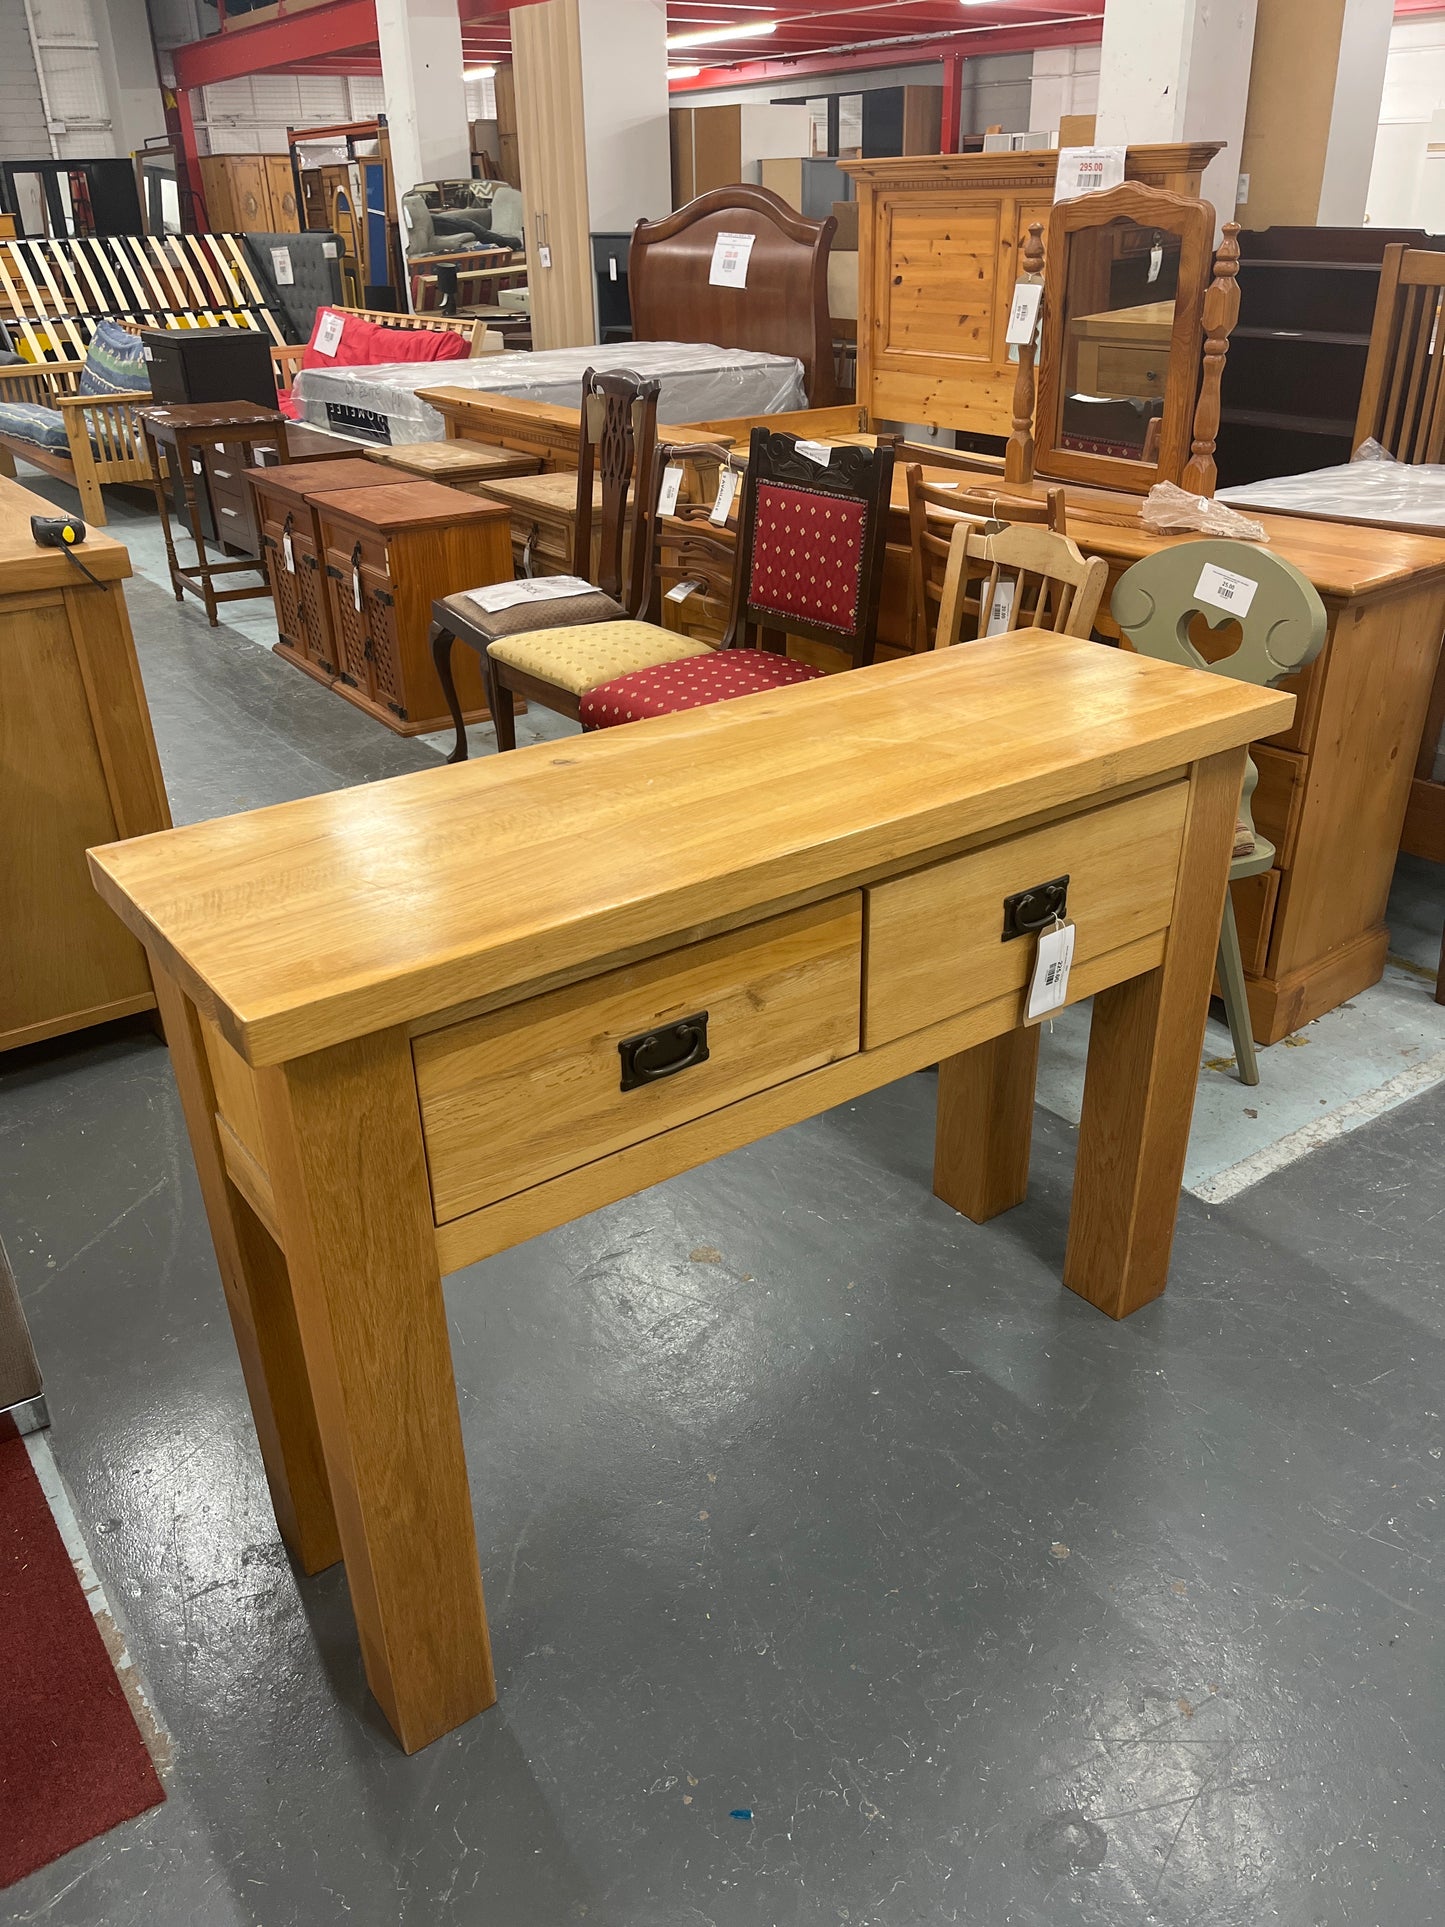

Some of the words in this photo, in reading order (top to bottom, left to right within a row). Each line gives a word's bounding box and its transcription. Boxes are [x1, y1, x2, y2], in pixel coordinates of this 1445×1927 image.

[1079, 162, 1103, 172] 295.00
[1222, 581, 1236, 591] 25.00
[1053, 960, 1063, 983] 225.00
